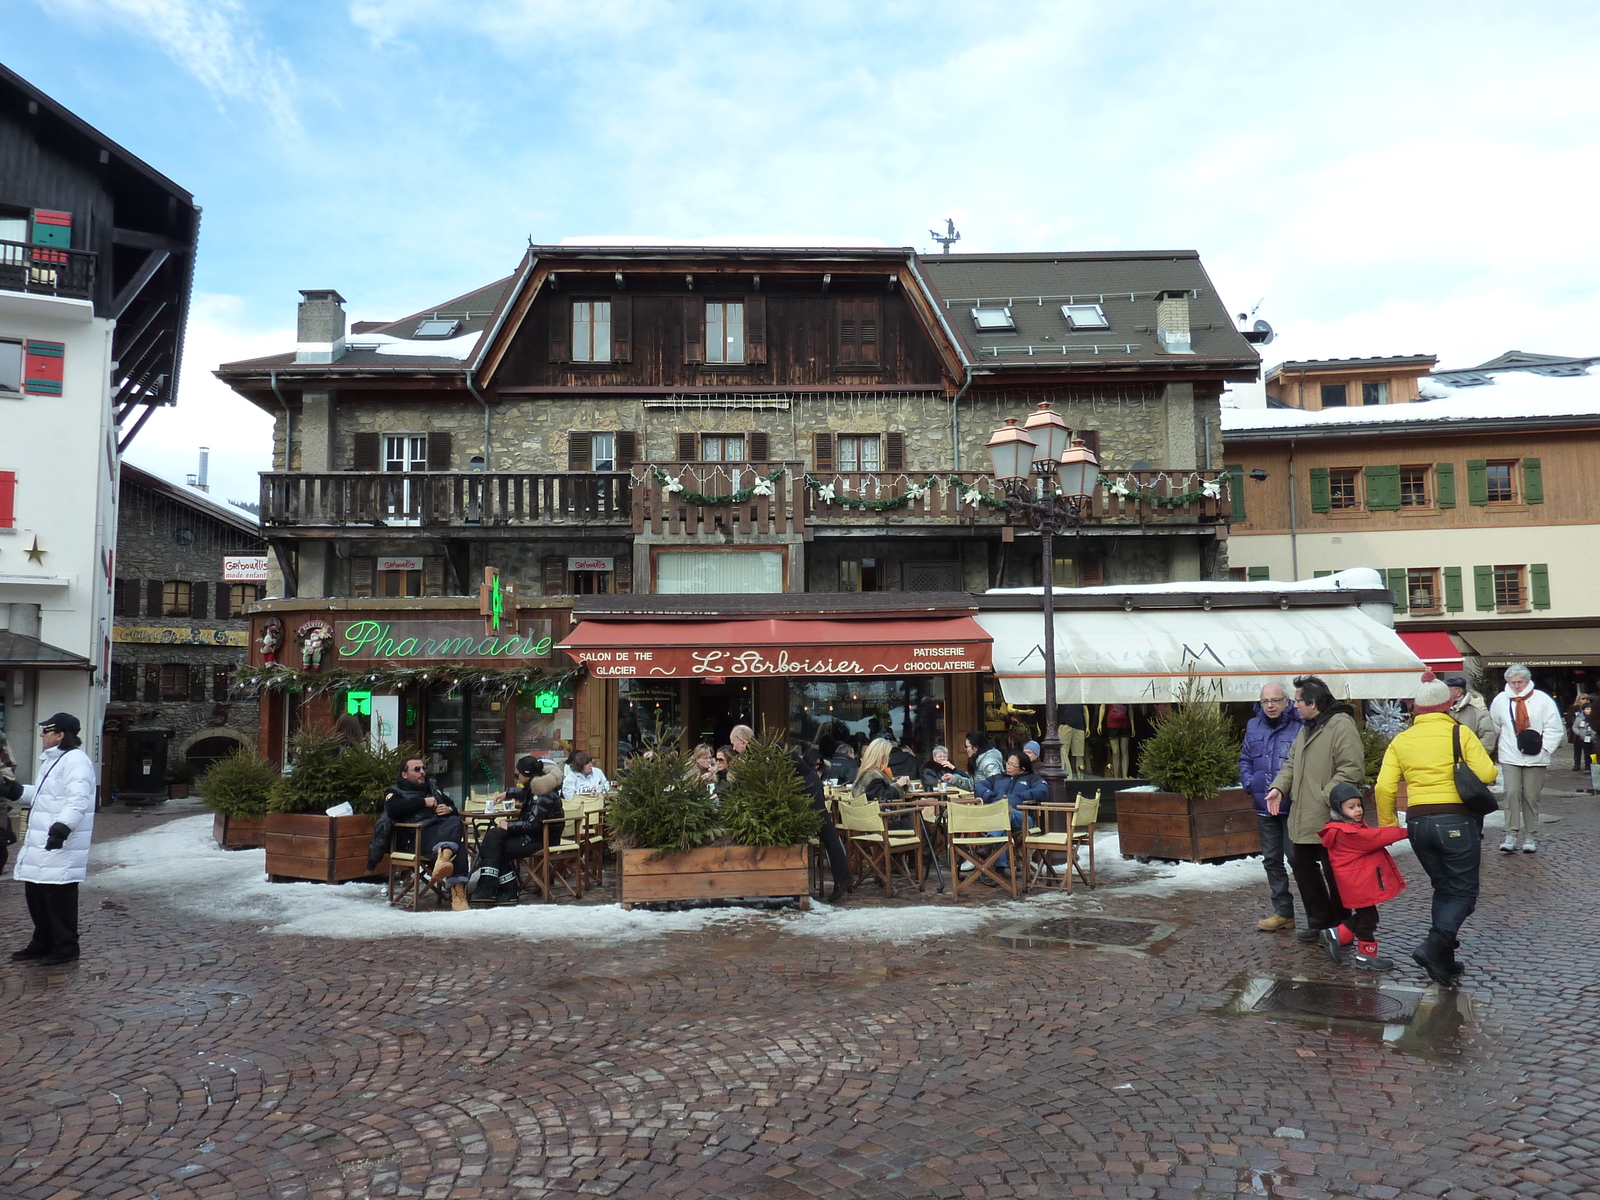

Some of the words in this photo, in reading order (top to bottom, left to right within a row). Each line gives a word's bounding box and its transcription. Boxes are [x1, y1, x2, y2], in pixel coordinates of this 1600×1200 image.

[121, 628, 147, 640] Club
[215, 632, 225, 642] 5
[339, 620, 552, 656] Pharmacie
[580, 652, 611, 660] SALON
[616, 652, 629, 660] DE
[634, 652, 652, 660] THE
[914, 648, 964, 656] PATISSERIE
[1010, 644, 1164, 666] Avenue
[692, 650, 864, 674] L'Arboisier
[904, 661, 975, 671] CHOCOLATERIE
[596, 666, 636, 674] GLACIER
